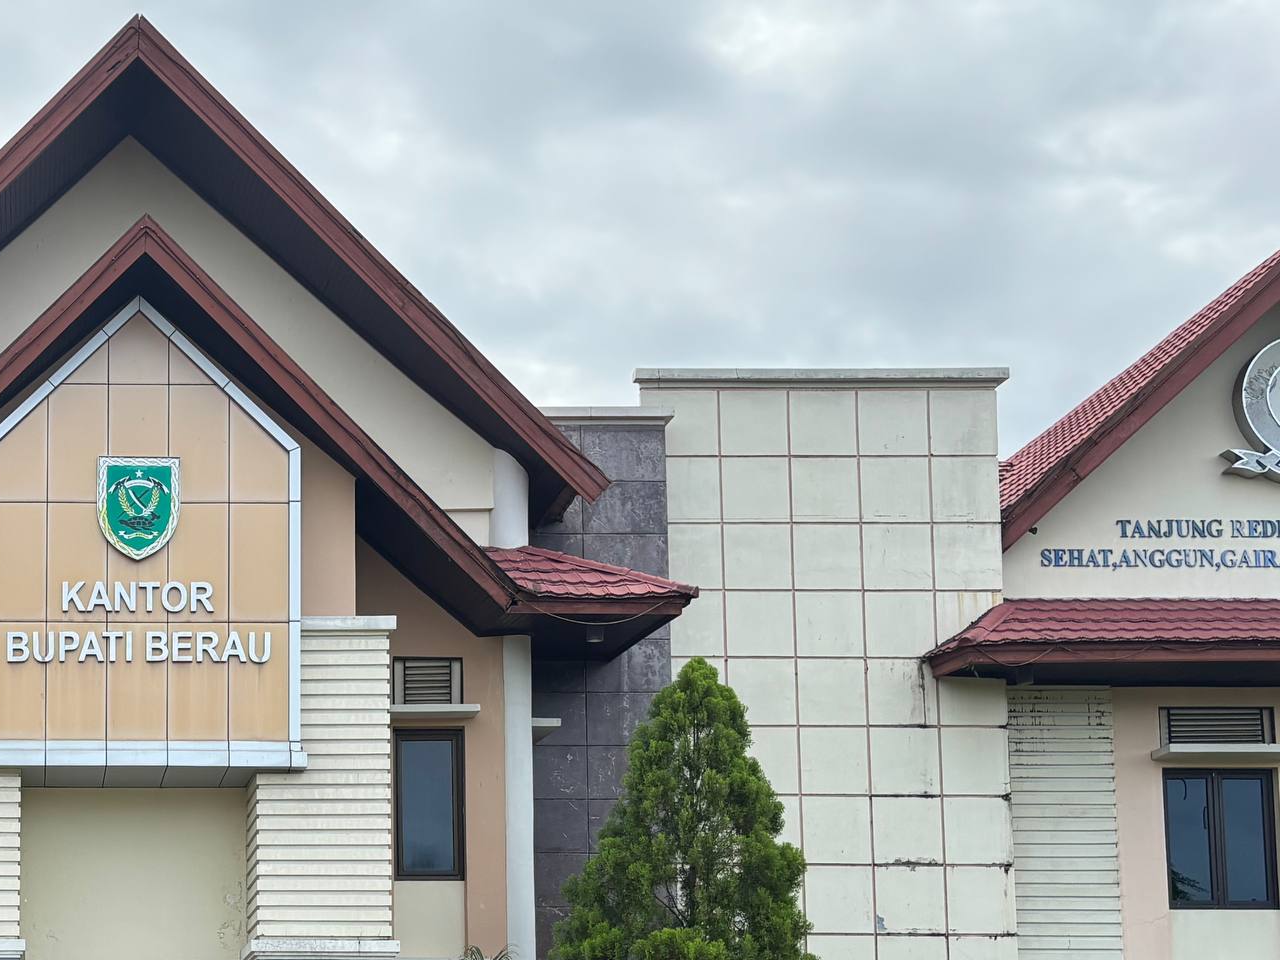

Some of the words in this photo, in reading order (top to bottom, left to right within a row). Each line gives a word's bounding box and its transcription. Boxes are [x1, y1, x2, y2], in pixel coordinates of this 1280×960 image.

[1116, 519, 1222, 539] TANJUNG
[61, 581, 214, 613] KANTOR
[6, 631, 133, 663] BUPATI
[145, 631, 271, 664] BERAU
